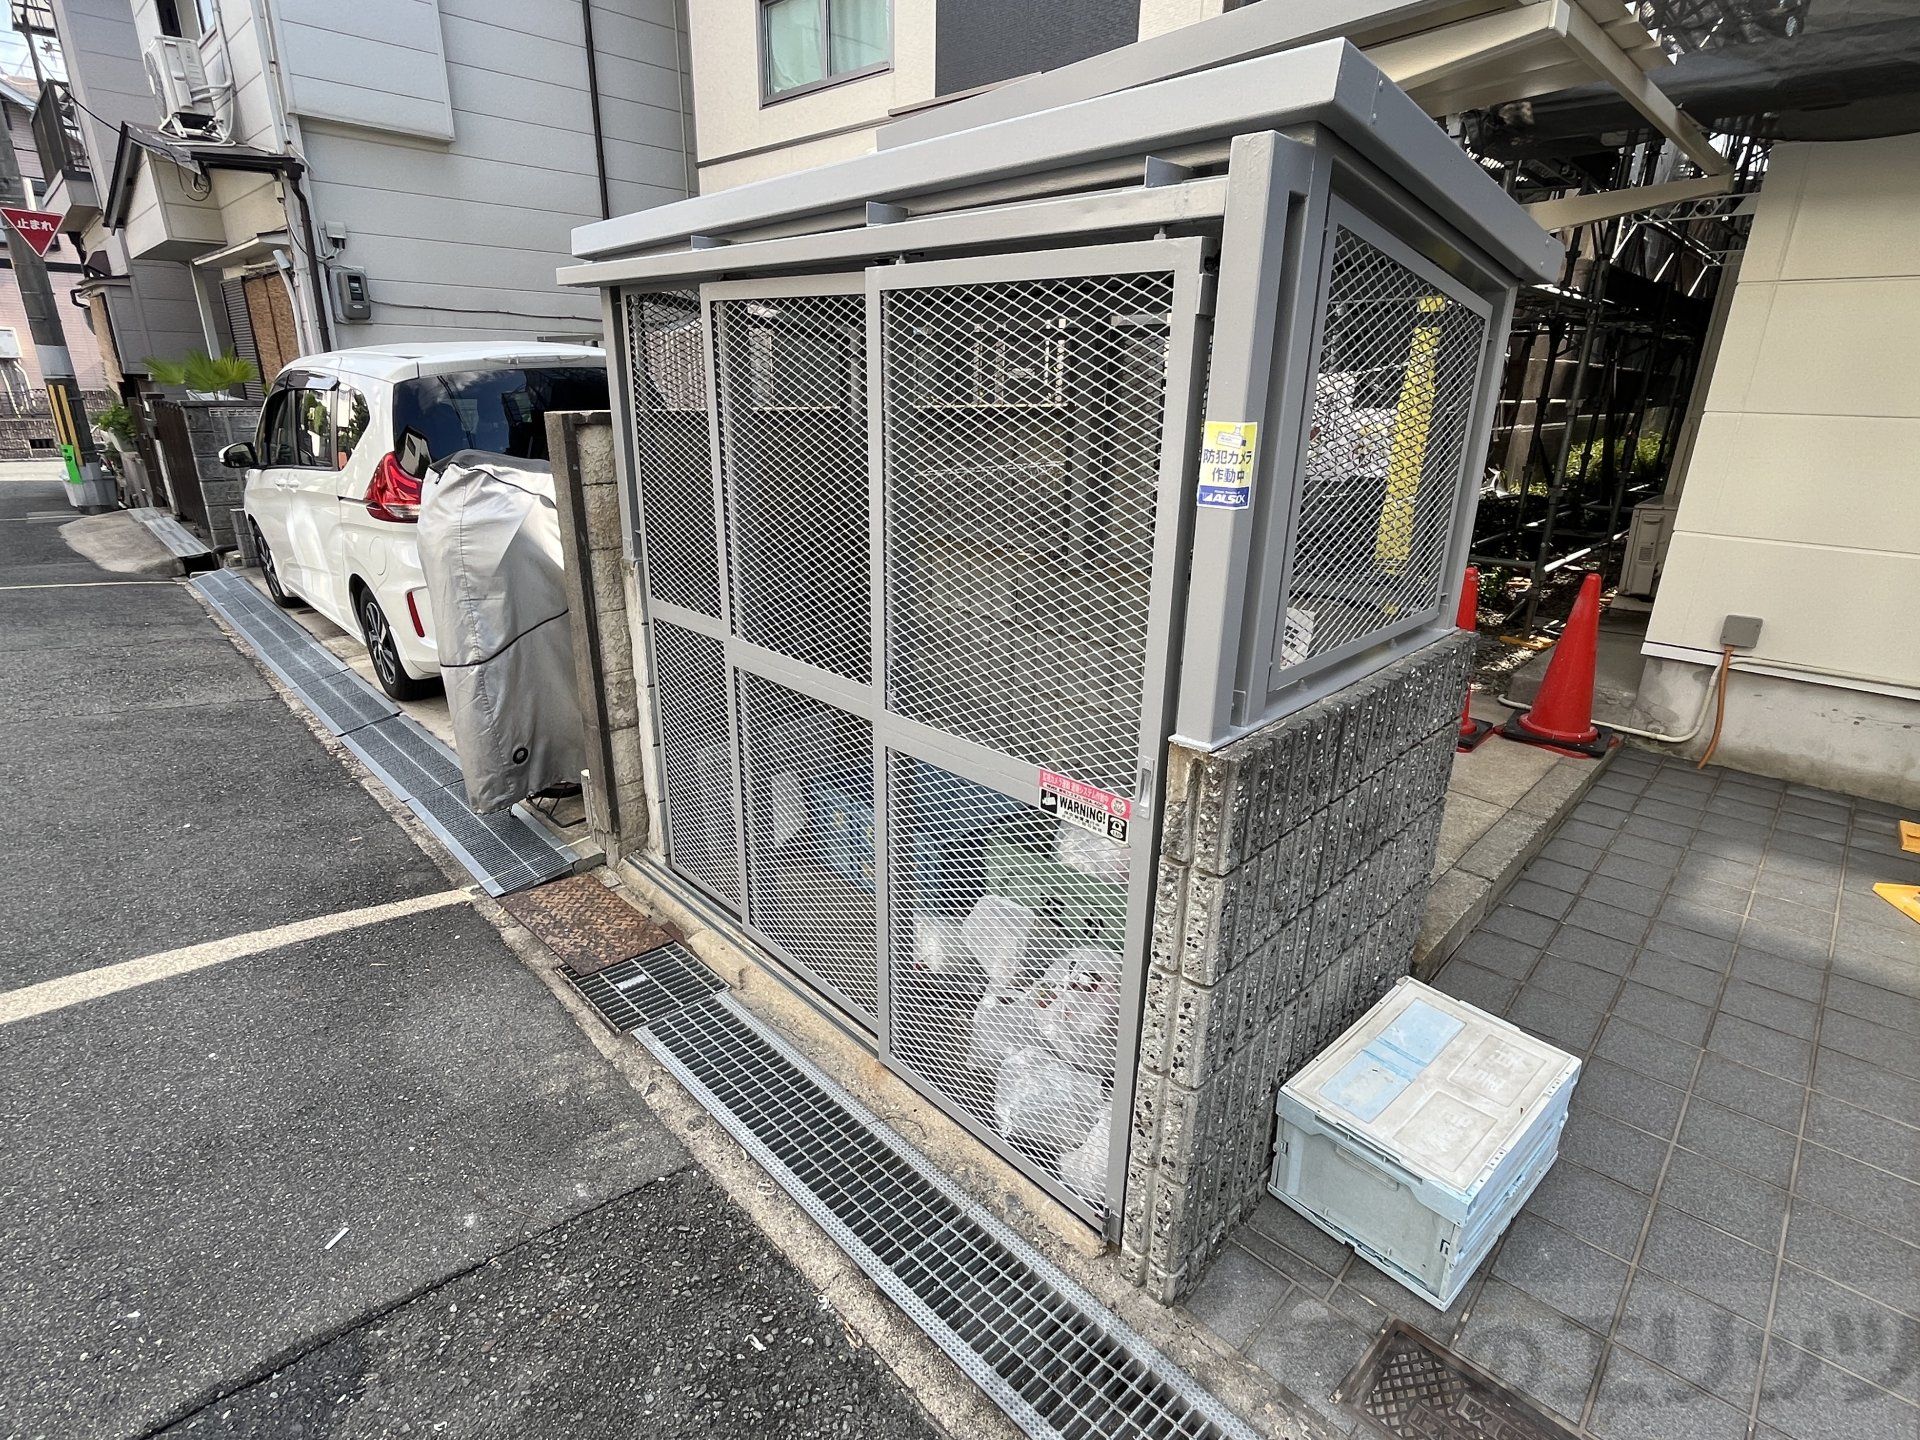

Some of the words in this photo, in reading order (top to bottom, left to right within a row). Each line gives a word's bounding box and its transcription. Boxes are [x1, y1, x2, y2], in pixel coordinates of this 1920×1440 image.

[17, 218, 54, 232] 止まれ
[1202, 448, 1252, 465] 防犯カメラ
[1212, 467, 1245, 484] 作動中
[1212, 492, 1246, 504] ALSOK
[1059, 795, 1106, 824] WARNING!
